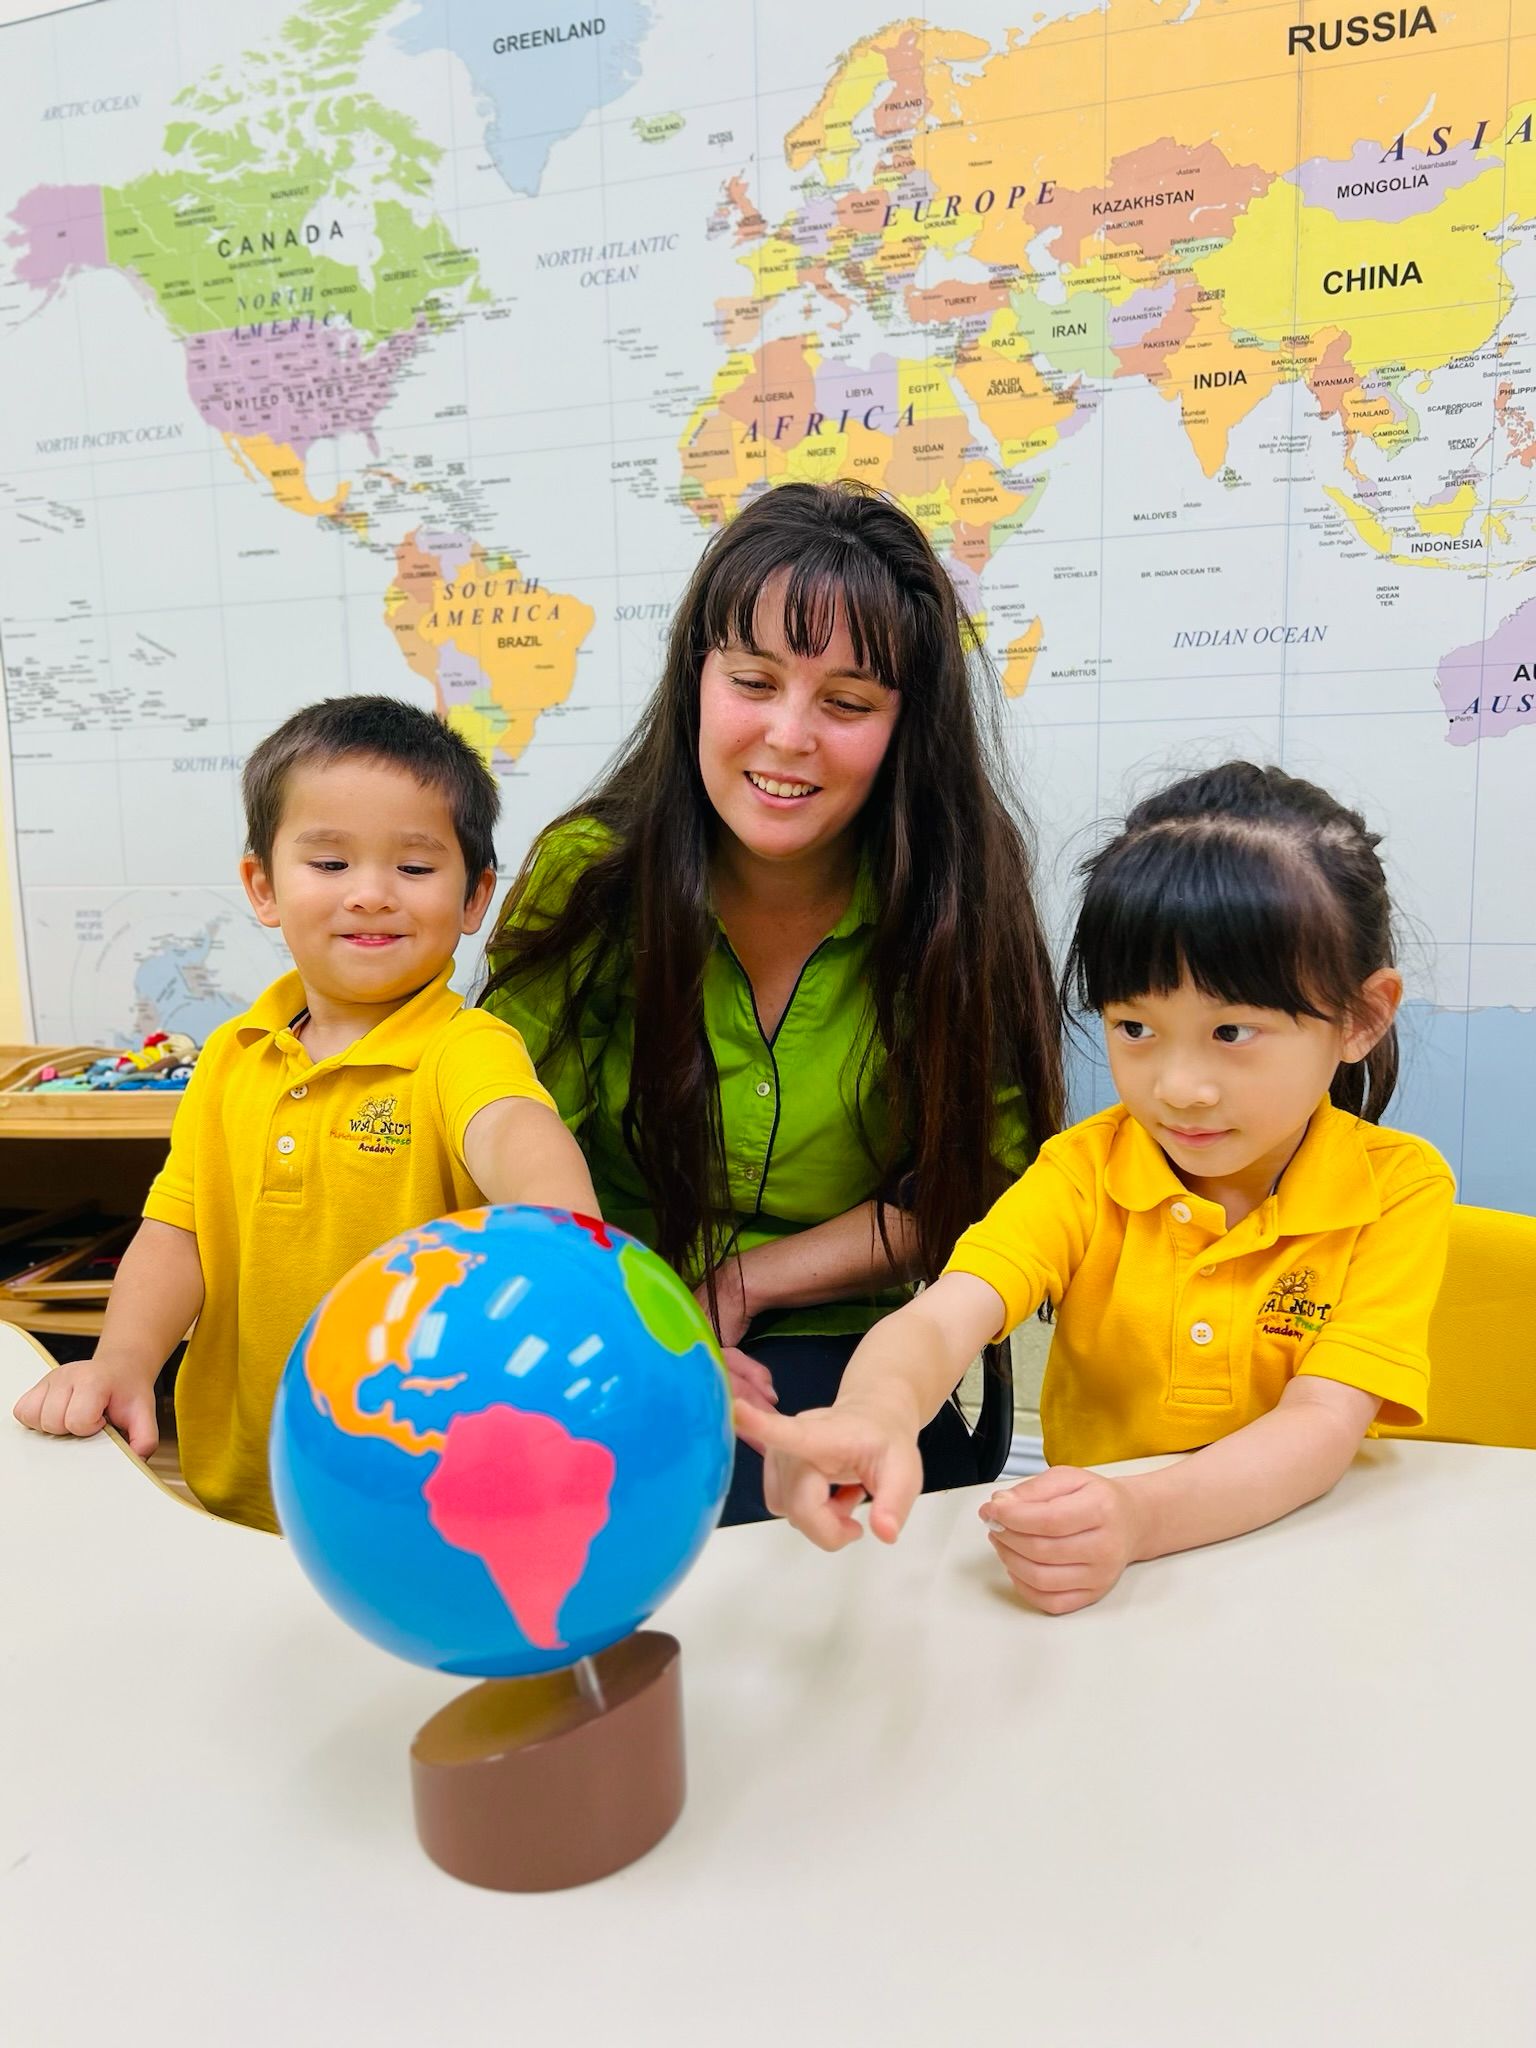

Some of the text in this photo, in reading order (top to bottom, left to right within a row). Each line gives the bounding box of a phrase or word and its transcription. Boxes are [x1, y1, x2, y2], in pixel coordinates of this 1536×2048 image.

[492, 18, 606, 55] GREENLAND
[1288, 5, 1438, 55] RUSSIA
[41, 95, 142, 122] ARCTIC OCEAN
[884, 98, 923, 112] FINLAND
[1378, 113, 1533, 164] ASIA
[1336, 173, 1430, 200] MONGOLIA
[881, 180, 1058, 229] EUROPE
[1091, 188, 1195, 216] KAZAKHSTAN
[924, 218, 958, 230] UKRAINE
[217, 220, 344, 258] CANADA
[536, 233, 680, 270] NORTH ATLANTIC
[1099, 248, 1145, 261] UZBEKISTAN
[1174, 242, 1224, 256] KYRGYZSTAN
[579, 265, 639, 288] OCEAN
[1322, 260, 1424, 296] CHINA
[235, 286, 314, 312] NORTH
[944, 295, 978, 307] TURKEY
[1112, 311, 1163, 324] AFGHANISTAN
[228, 309, 353, 341] AMERICA
[1051, 322, 1088, 339] IRAN
[991, 337, 1016, 348] IRAQ
[1143, 339, 1181, 350] PAKISTAN
[990, 377, 1021, 388] SAUDI
[1193, 369, 1248, 390] INDIA
[1313, 376, 1355, 388] MYANMAR
[845, 387, 874, 399] LIBYA
[908, 382, 941, 394] EGYPT
[986, 385, 1025, 397] ARABIA
[223, 384, 344, 411] UNITED STATES
[752, 390, 795, 404] ALGERIA
[1352, 408, 1390, 419] THAILAND
[739, 400, 916, 445] AFRICA
[35, 423, 185, 455] NORTH PACIFIC OCEAN
[1373, 428, 1409, 438] CAMBODIA
[912, 443, 945, 455] SUDAN
[1021, 439, 1048, 449] YEMEN
[806, 446, 837, 457] NIGER
[853, 456, 880, 467] CHAD
[1378, 474, 1413, 483] MALAYSIA
[960, 495, 999, 506] ETHIOPIA
[1133, 510, 1178, 522] MALDIVES
[1411, 538, 1484, 554] INDONESIA
[443, 577, 540, 601] SOUTH
[426, 604, 561, 629] AMERICA
[613, 602, 672, 622] SOUTH
[497, 636, 543, 649] BRAZIL
[1173, 625, 1329, 649] INDIAN OCEAN
[1051, 668, 1098, 679] MAURITIUS
[172, 757, 220, 773] SOUTH
[358, 1143, 396, 1155] Academy
